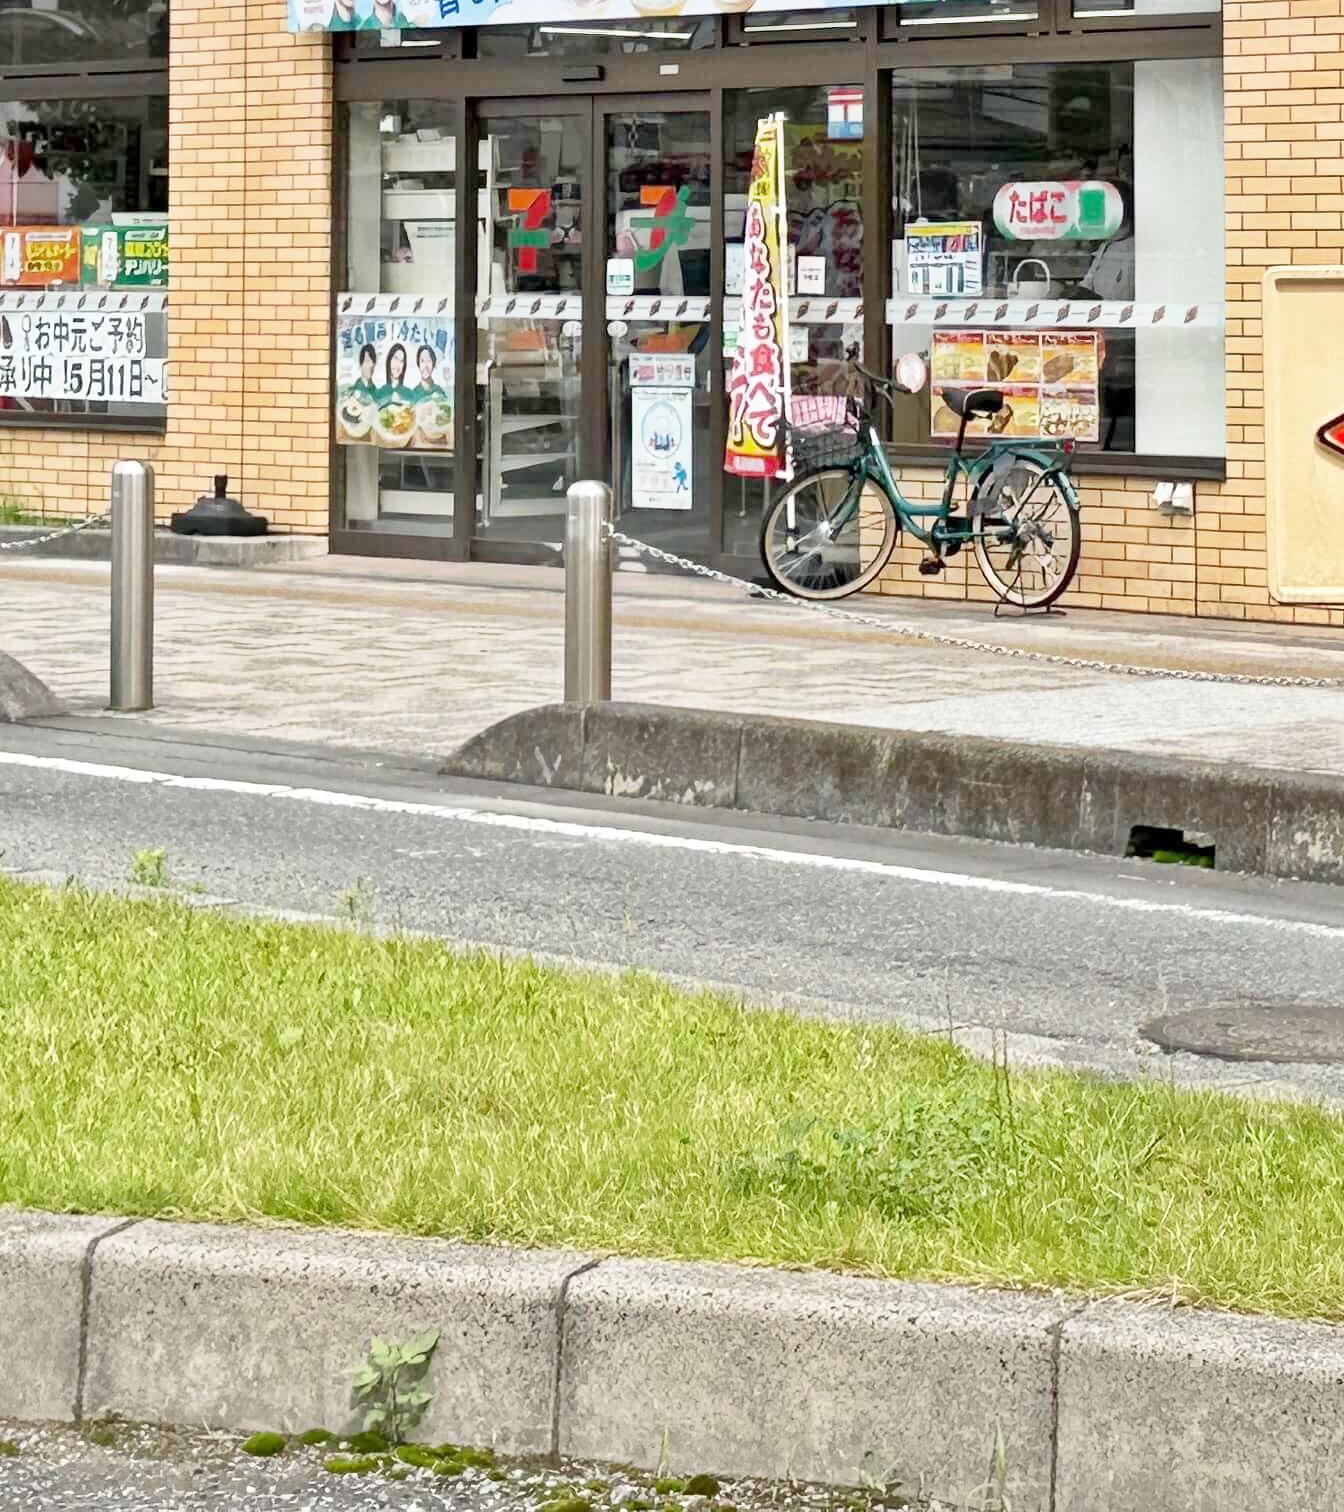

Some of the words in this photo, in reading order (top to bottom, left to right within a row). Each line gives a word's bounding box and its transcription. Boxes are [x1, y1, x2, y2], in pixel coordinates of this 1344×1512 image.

[1009, 190, 1067, 223] たばこ
[35, 314, 143, 354] お中元ご予約
